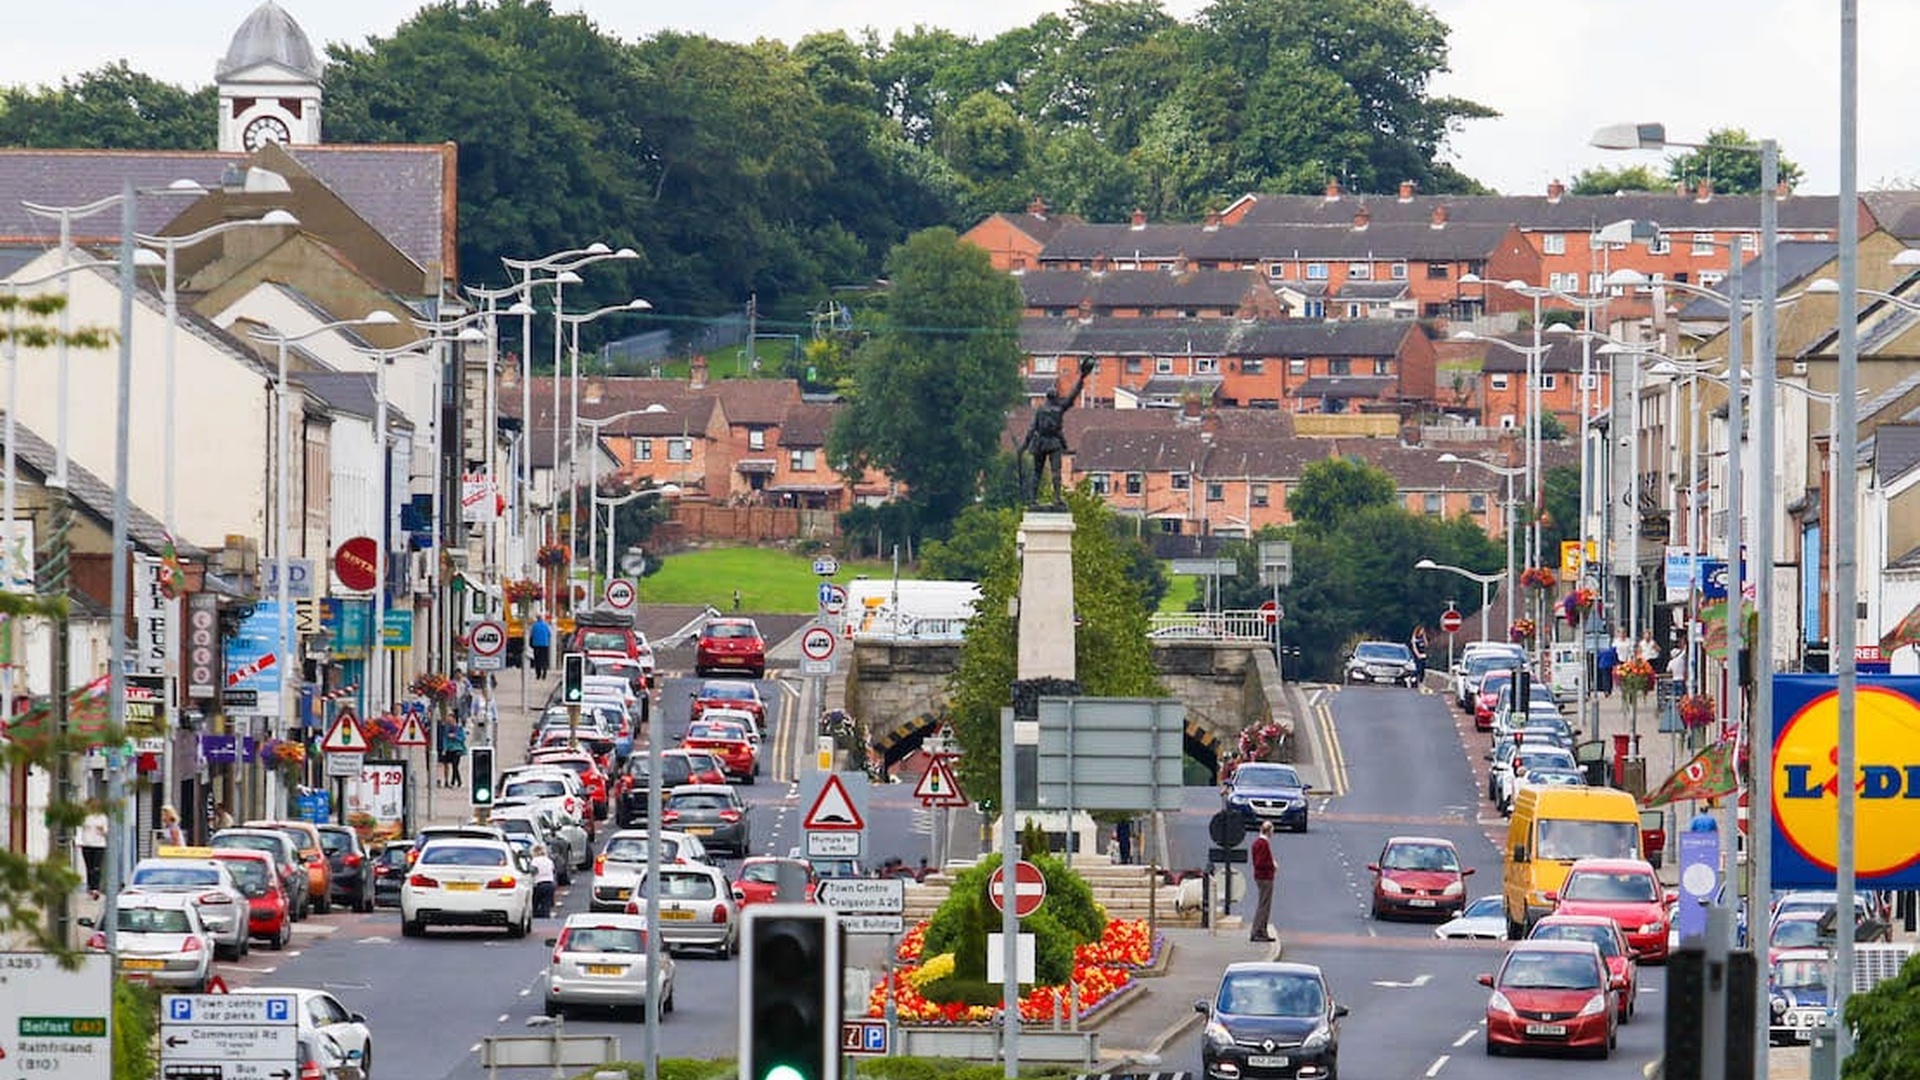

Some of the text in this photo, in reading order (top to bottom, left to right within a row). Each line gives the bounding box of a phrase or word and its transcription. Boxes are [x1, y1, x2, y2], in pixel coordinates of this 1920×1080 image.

[1854, 647, 1880, 660] REE
[830, 883, 888, 892] Town Centre
[22, 1020, 70, 1033] Belfast
[191, 1029, 258, 1040] Commercial
